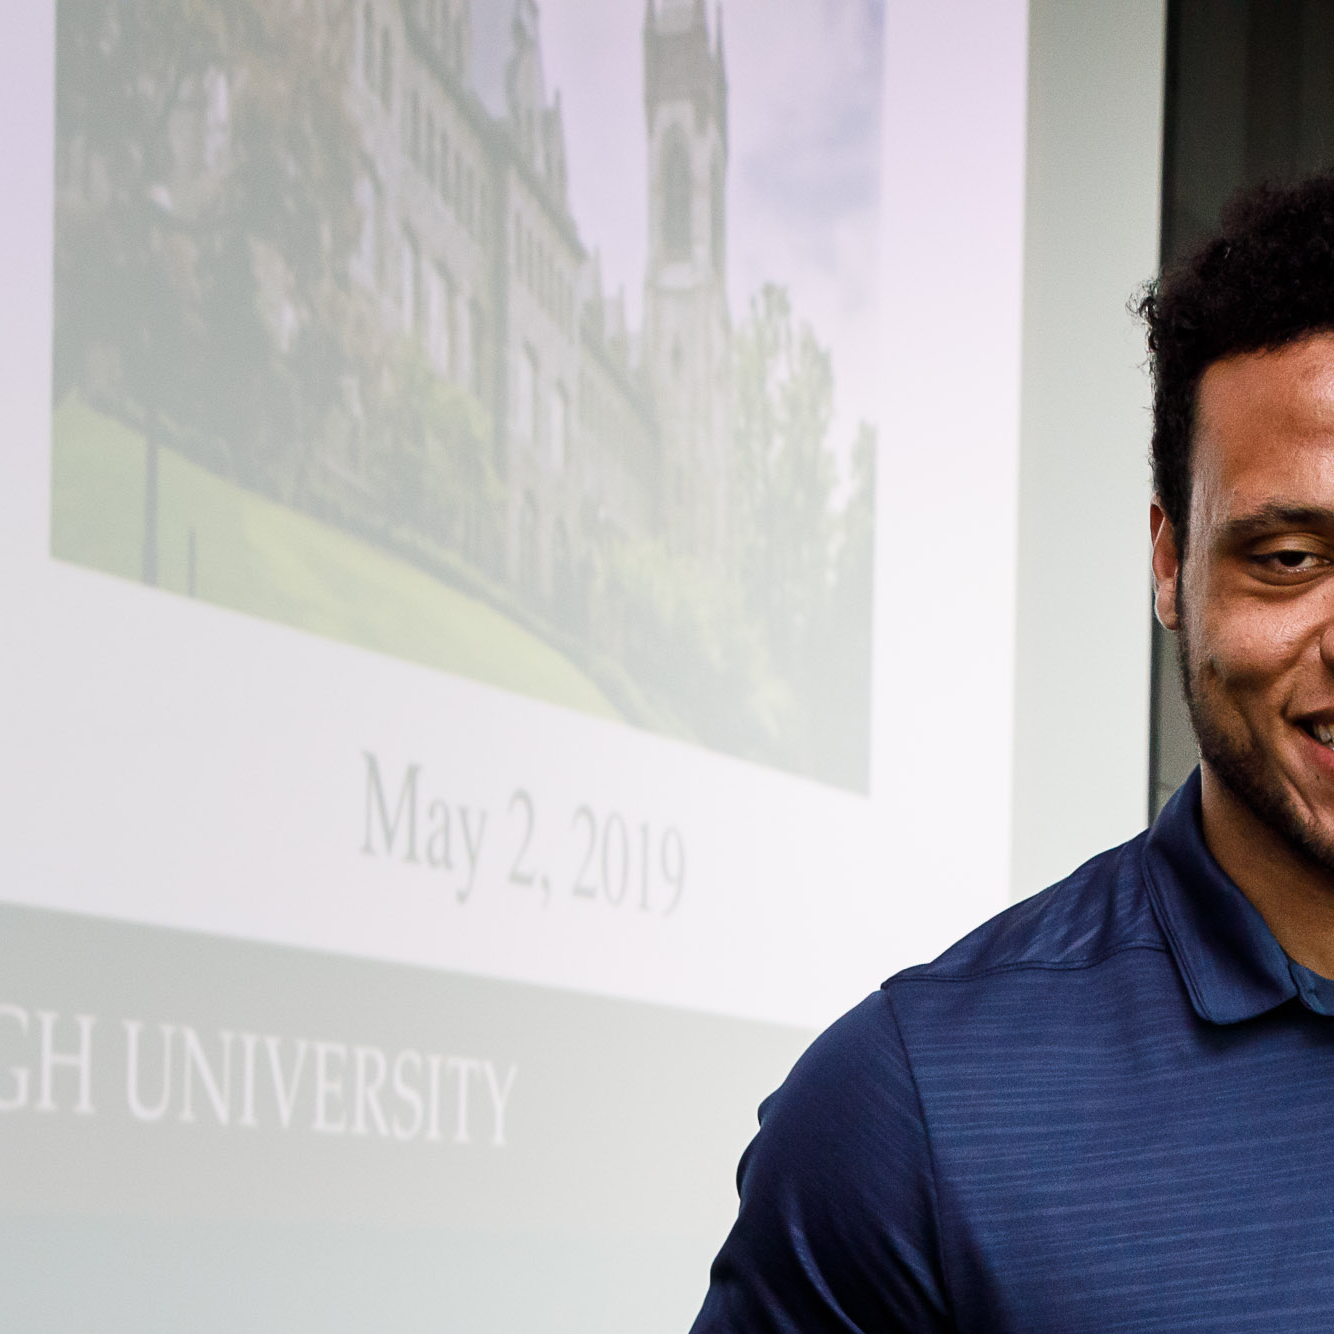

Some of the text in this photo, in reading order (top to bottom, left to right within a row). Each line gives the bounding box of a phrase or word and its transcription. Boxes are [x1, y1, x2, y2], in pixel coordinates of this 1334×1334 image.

[361, 748, 686, 917] May 2, 2019
[121, 1018, 519, 1148] UNIVERSITY
